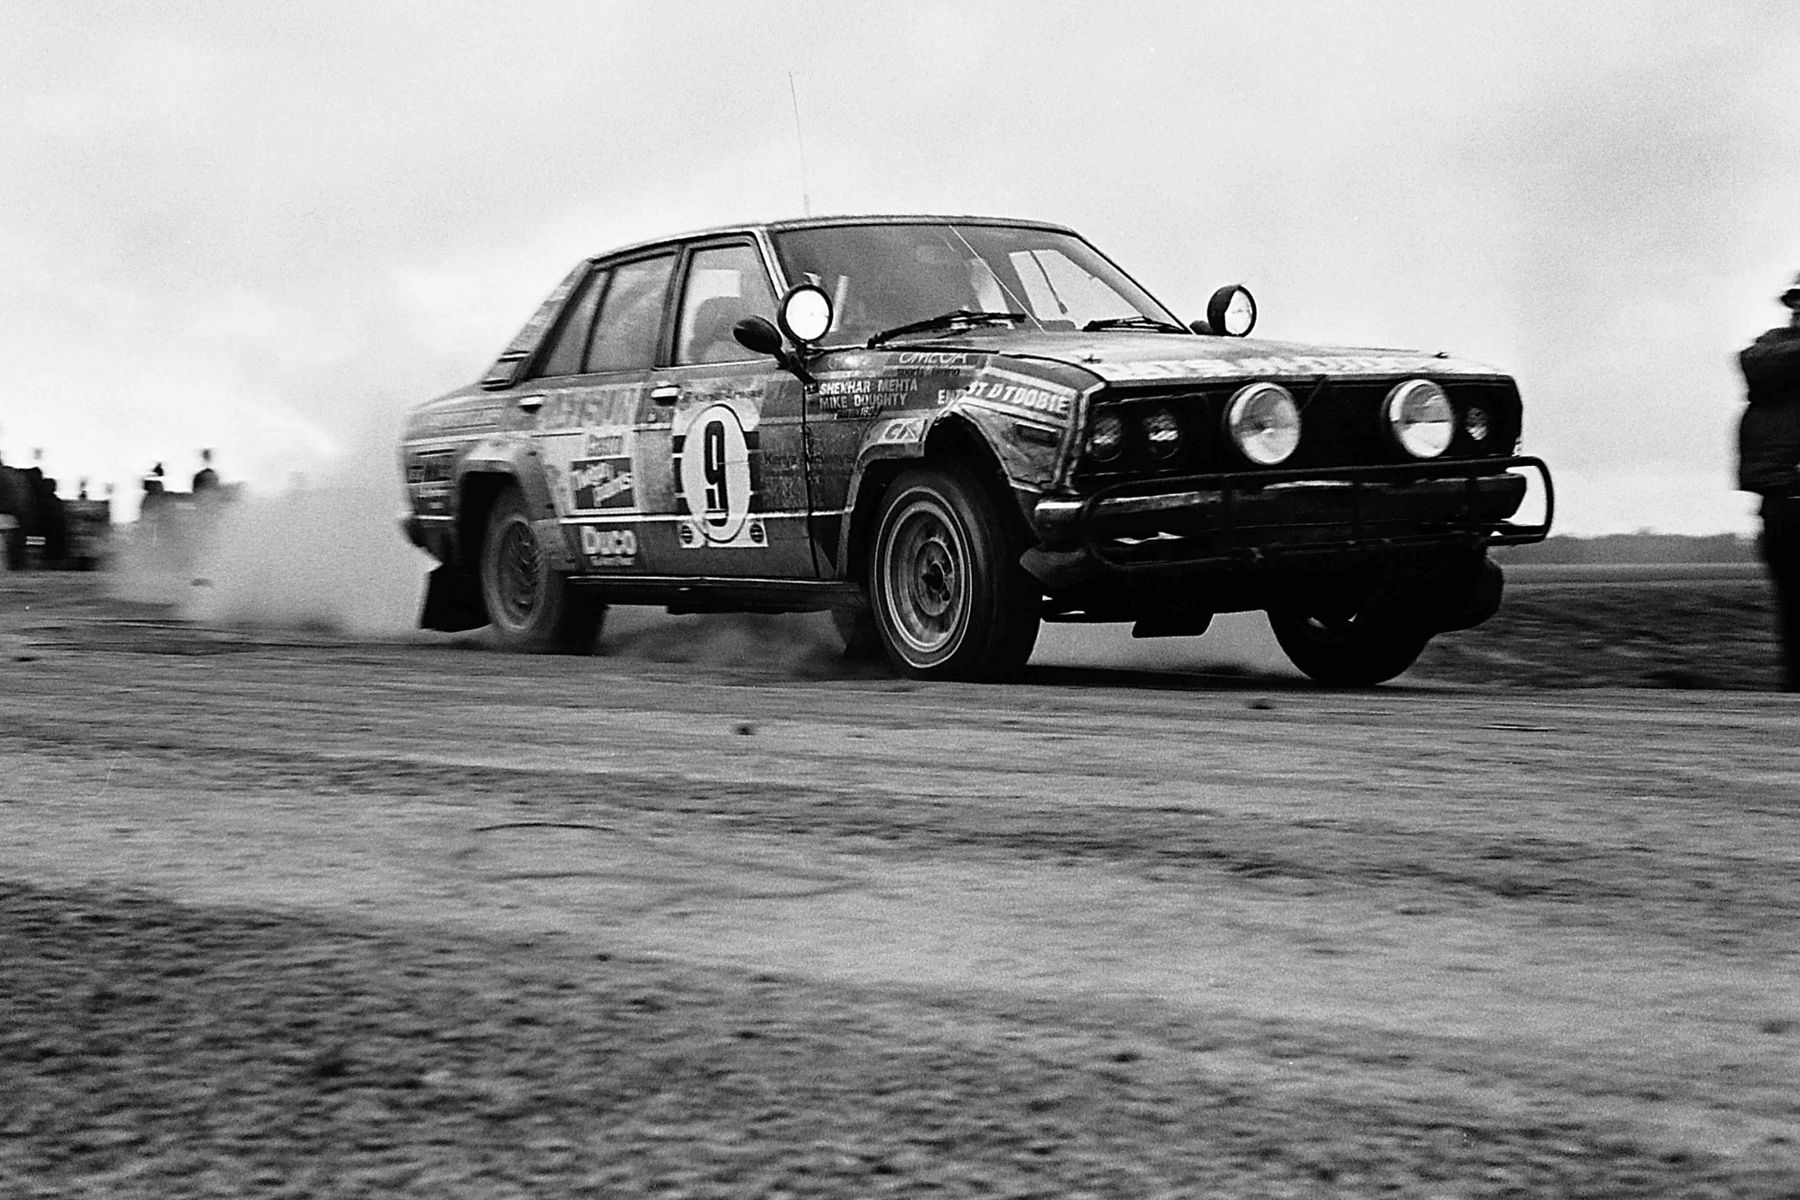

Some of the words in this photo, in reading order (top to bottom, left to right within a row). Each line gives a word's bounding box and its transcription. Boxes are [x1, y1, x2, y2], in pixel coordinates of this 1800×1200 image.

[819, 380, 871, 396] SHEKHAR
[877, 378, 918, 393] MEHTA
[819, 395, 848, 410] MIKE
[853, 392, 908, 409] DOUGHTY
[1011, 387, 1070, 414] DOBIE
[704, 420, 729, 527] 9
